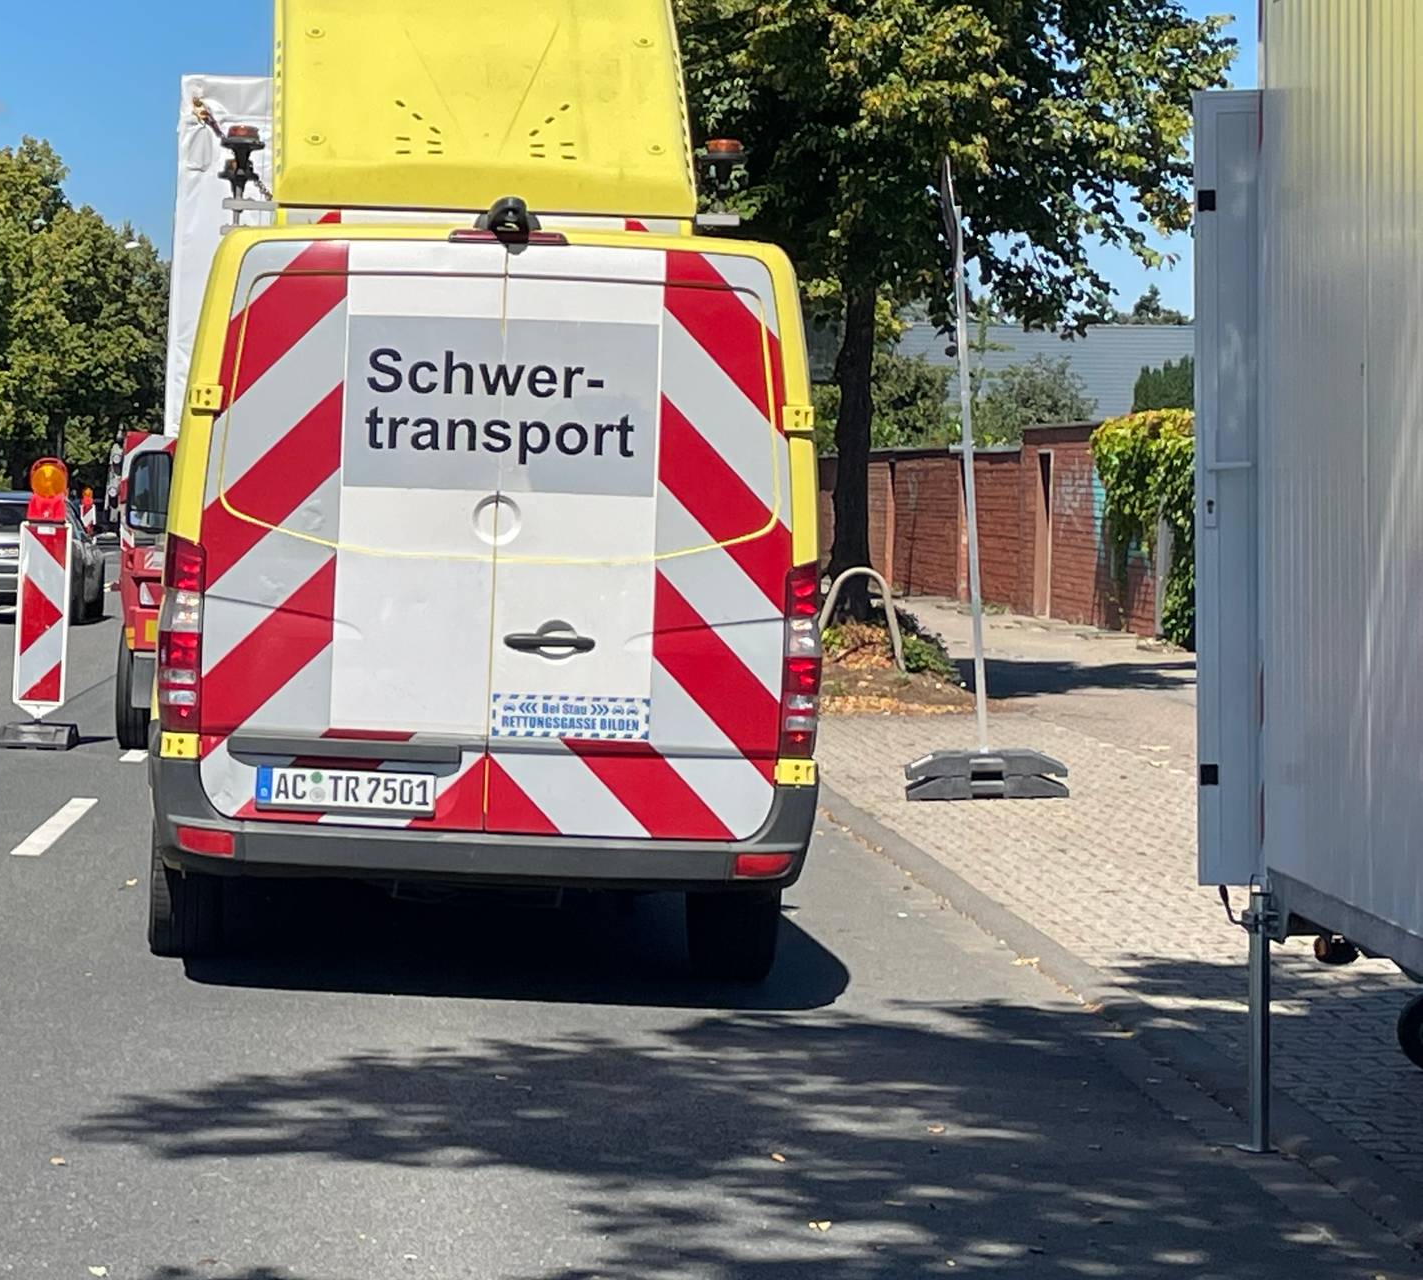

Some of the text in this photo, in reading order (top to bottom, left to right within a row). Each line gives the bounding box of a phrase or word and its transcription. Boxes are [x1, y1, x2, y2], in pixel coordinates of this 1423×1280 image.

[367, 348, 604, 398] Schwer-
[365, 406, 634, 465] transport
[502, 715, 639, 731] RETTUNGSGASSE BILDEN
[542, 703, 587, 715] Bei Stau
[275, 773, 430, 806] AC TR 7501
